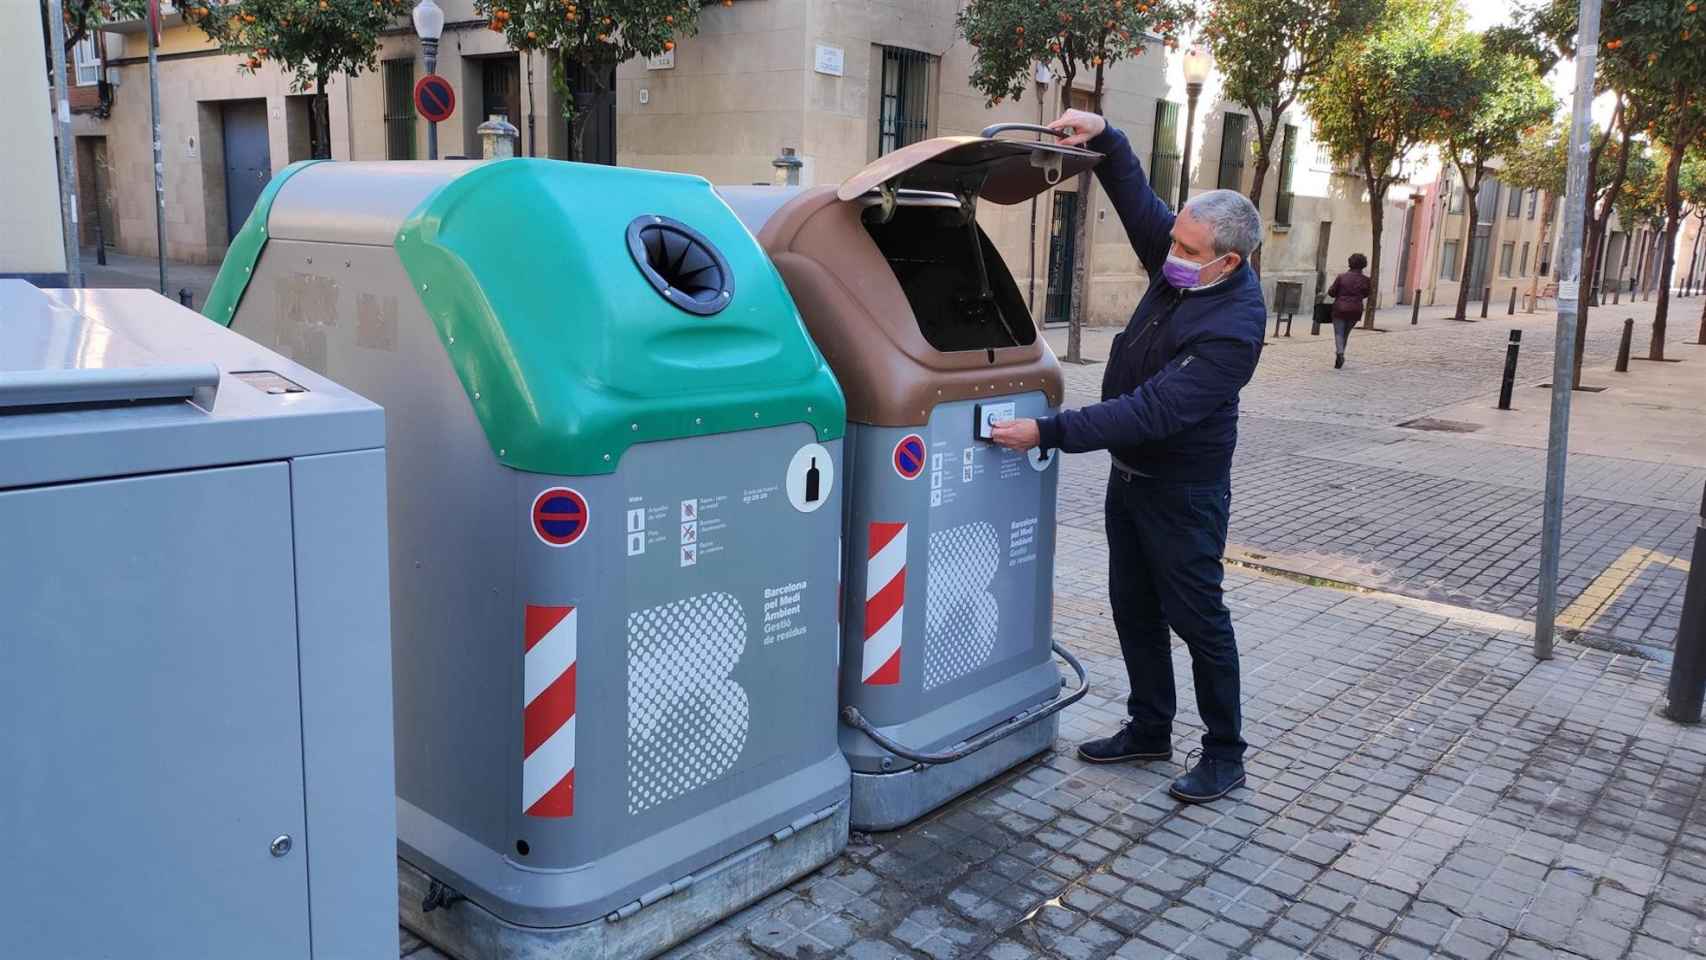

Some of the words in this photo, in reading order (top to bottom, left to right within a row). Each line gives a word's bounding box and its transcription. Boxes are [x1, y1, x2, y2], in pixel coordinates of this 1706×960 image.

[763, 581, 807, 599] Barcelona
[763, 598, 778, 612] pel
[779, 591, 800, 607] Medi
[763, 604, 800, 623] Ambient
[763, 618, 791, 633] Gestió
[763, 635, 774, 645] de
[776, 626, 807, 641] residus
